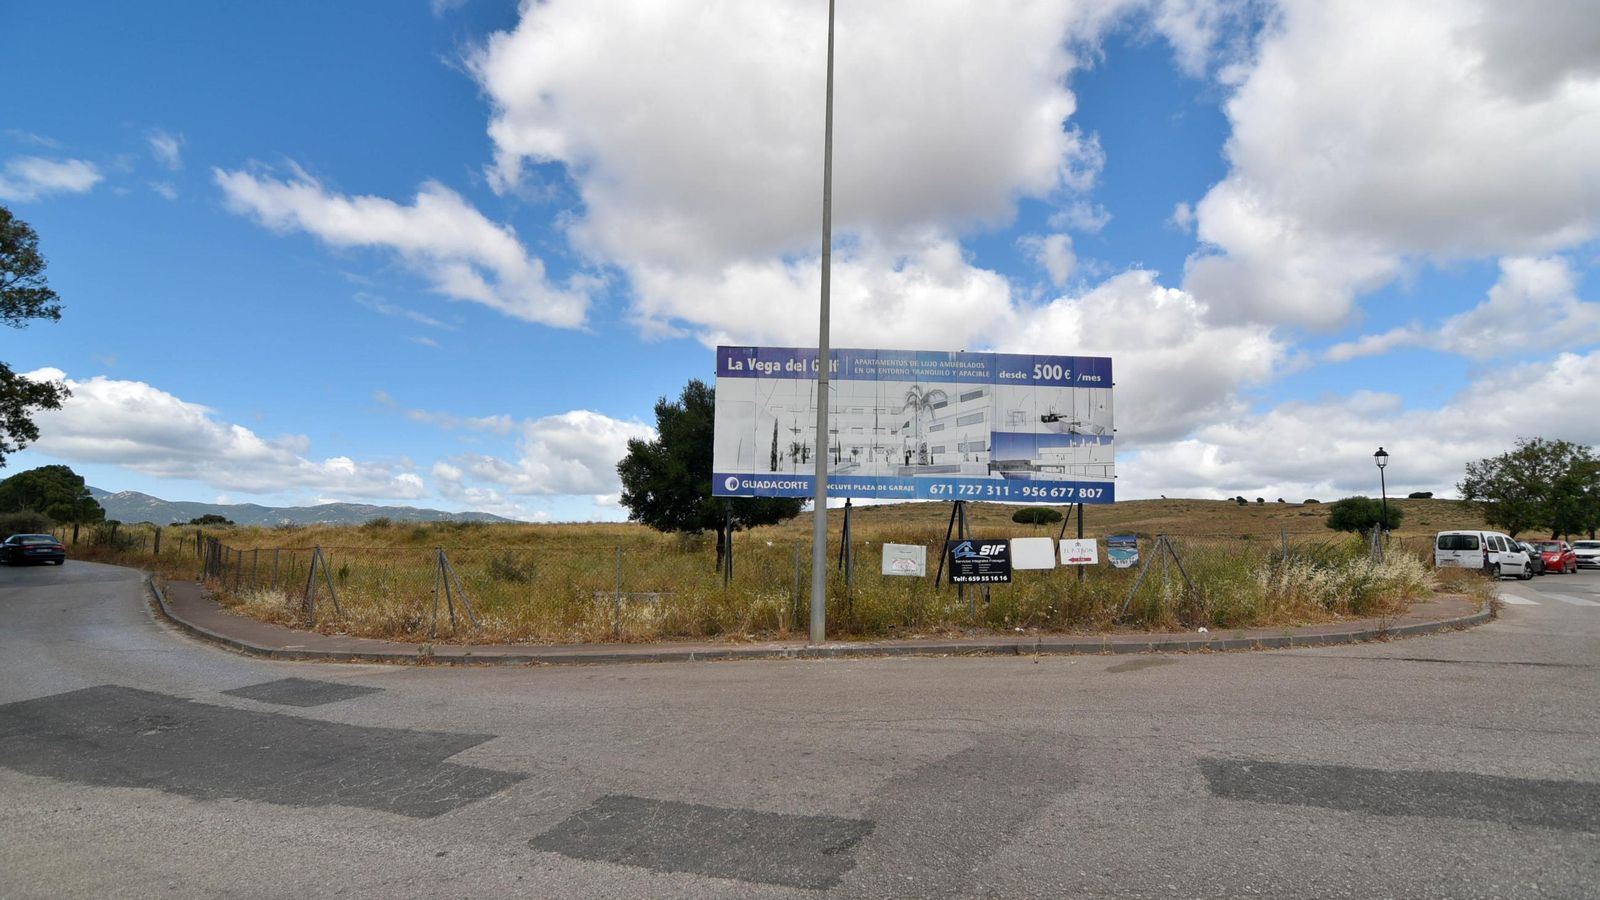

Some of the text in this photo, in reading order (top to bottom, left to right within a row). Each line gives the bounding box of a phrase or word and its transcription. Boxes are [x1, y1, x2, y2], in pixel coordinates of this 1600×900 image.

[728, 357, 839, 374] La Vega del Glf
[854, 359, 908, 367] APARTAMENTOS
[940, 361, 985, 369] AMUEBLADOS
[912, 369, 950, 377] TRANQUILO
[959, 370, 990, 378] APACIBLE
[999, 370, 1027, 380] desde
[1077, 373, 1102, 382] /mes
[741, 479, 808, 490] GUADACORTE
[929, 484, 953, 494] 671
[959, 484, 981, 495] 727
[987, 485, 1010, 496] 311
[1022, 486, 1047, 497] 956
[1051, 487, 1074, 498] 677
[1079, 488, 1103, 499] 807
[979, 544, 1006, 556] SIF
